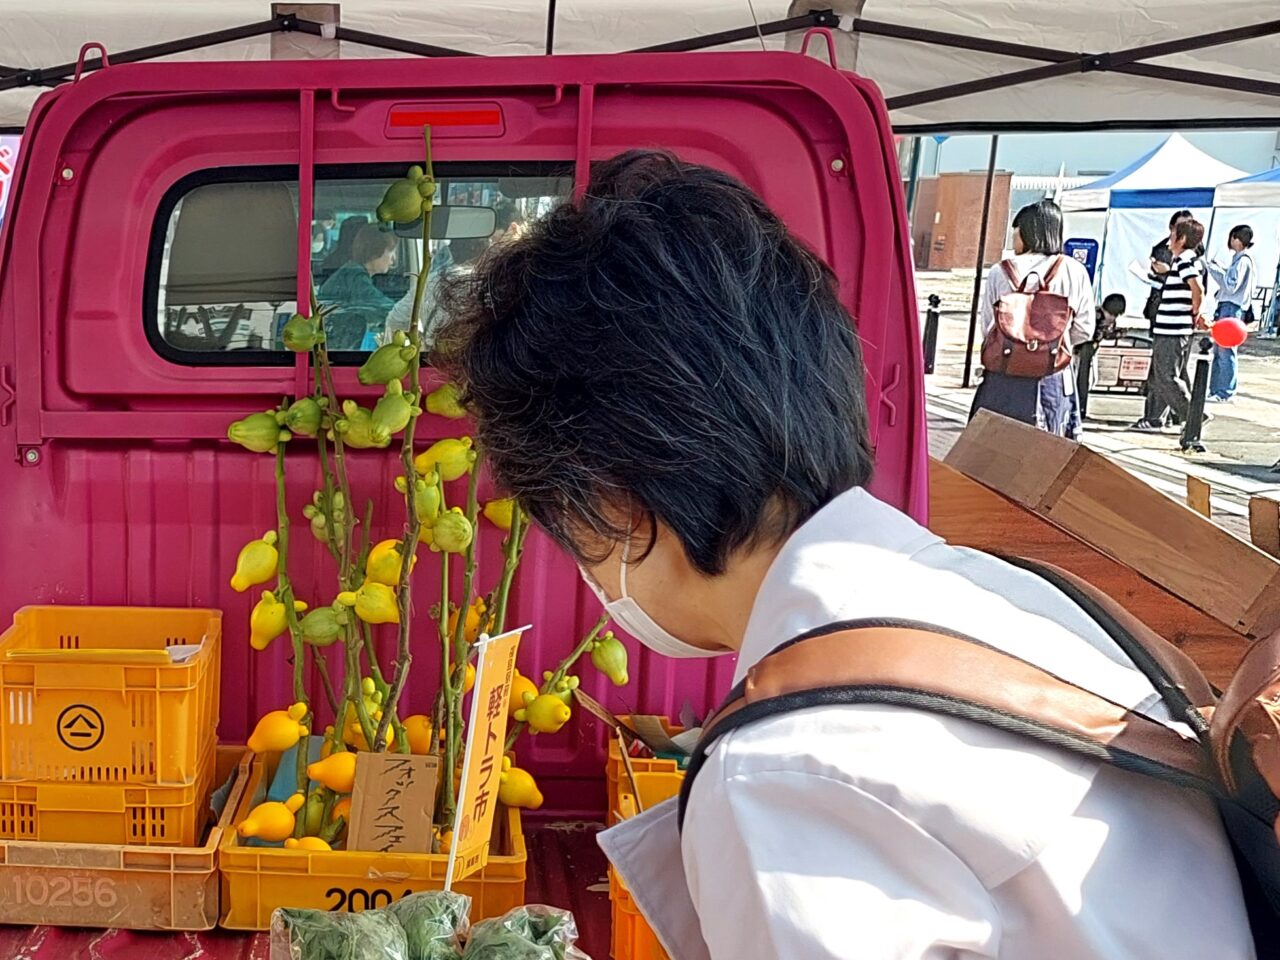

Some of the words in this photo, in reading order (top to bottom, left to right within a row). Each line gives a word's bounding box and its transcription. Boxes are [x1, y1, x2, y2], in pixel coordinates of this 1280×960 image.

[473, 682, 504, 825] 軽トラ市
[12, 874, 118, 908] 10256
[324, 887, 413, 912] 200
